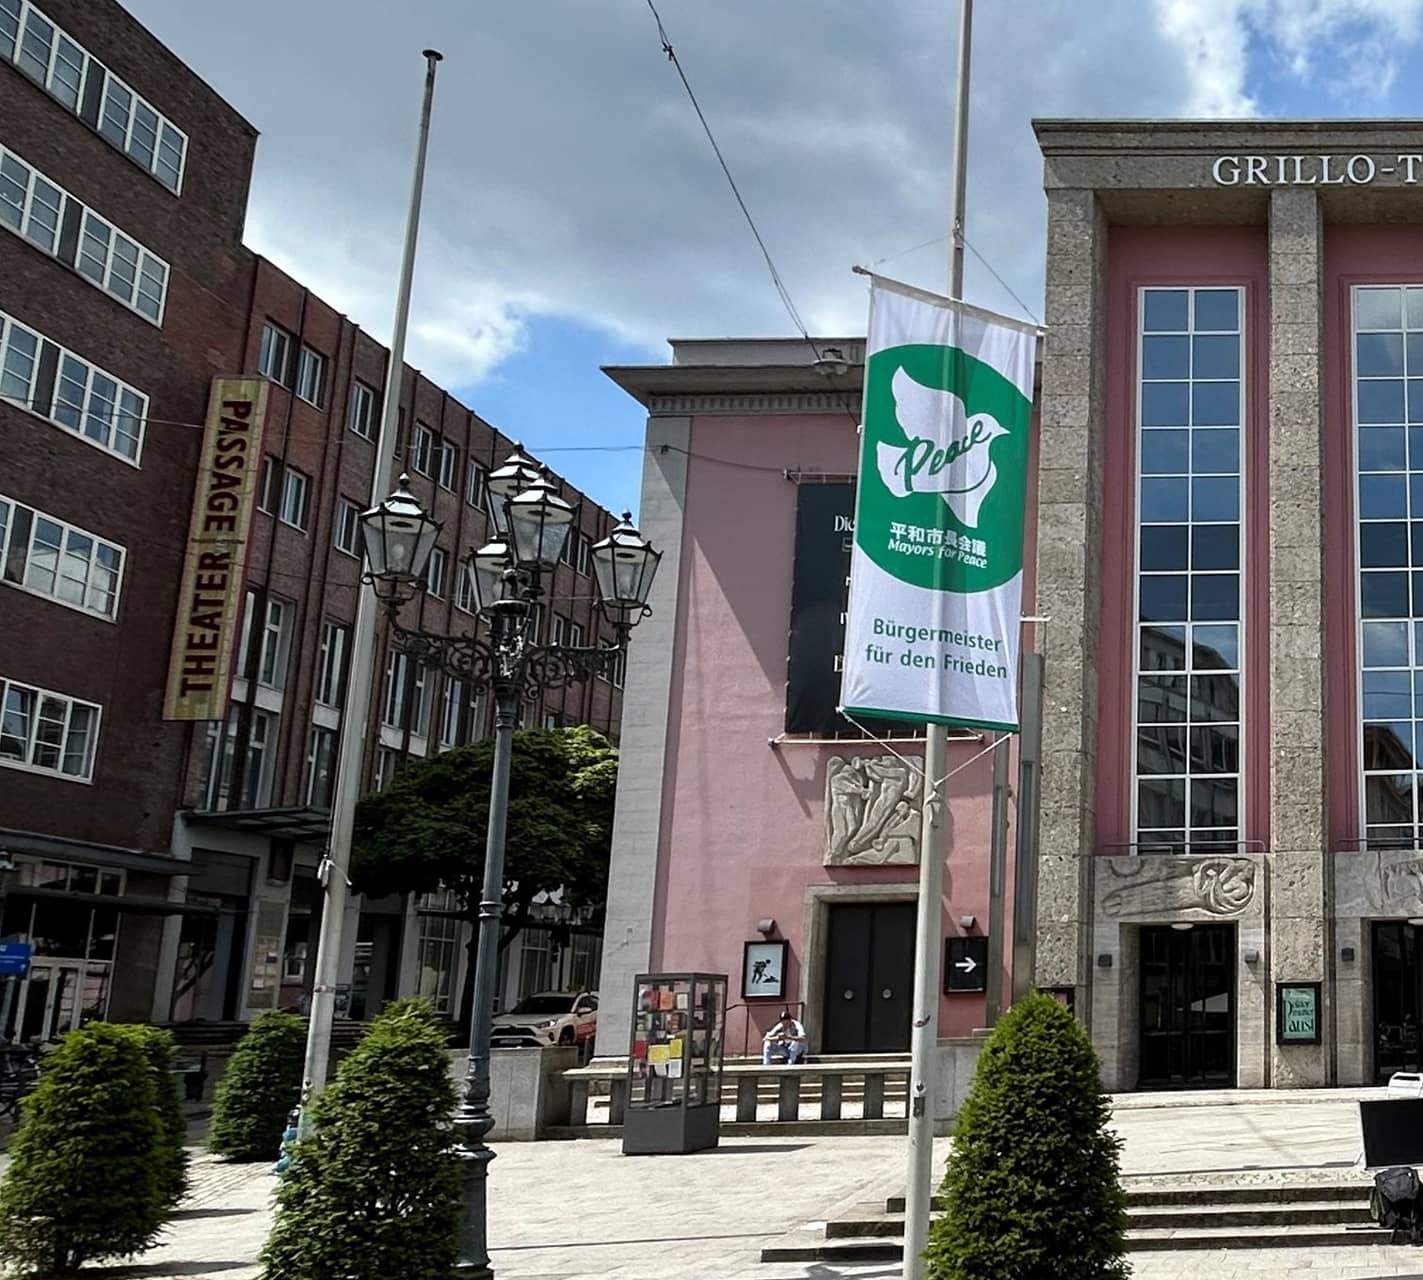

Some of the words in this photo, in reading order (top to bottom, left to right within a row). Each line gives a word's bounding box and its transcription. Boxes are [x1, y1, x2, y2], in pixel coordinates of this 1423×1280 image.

[204, 399, 252, 532] PASSAGE
[894, 420, 992, 492] Peace
[888, 538, 935, 557] Mayors
[937, 546, 957, 559] for
[957, 551, 988, 569] Peace
[179, 551, 231, 697] THEATER
[873, 617, 1002, 652] Bürgermeister
[865, 643, 893, 664] für
[900, 648, 936, 669] den
[944, 654, 1008, 678] Frieden
